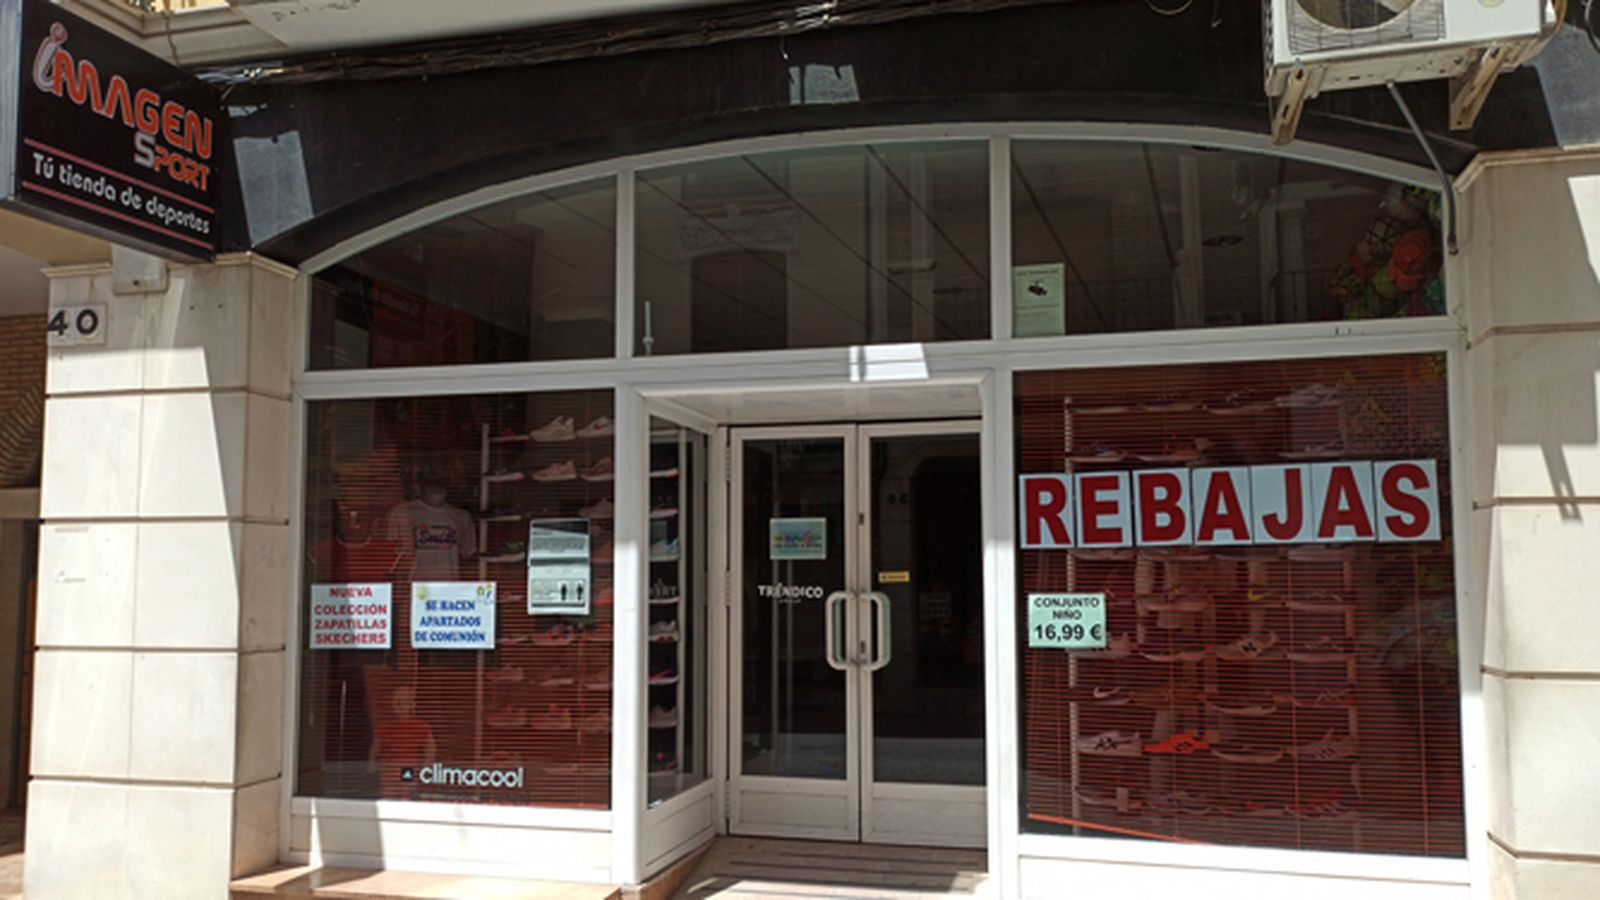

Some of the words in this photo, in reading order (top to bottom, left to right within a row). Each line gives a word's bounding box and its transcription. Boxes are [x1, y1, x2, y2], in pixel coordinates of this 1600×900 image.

[134, 131, 210, 191] SPORT
[33, 152, 54, 179] Tú
[59, 164, 116, 201] tienda
[121, 186, 142, 210] de
[146, 196, 210, 233] deportes
[47, 308, 99, 336] 40
[1024, 463, 1431, 545] REBAJAS
[329, 586, 373, 598] NUEVA
[425, 600, 438, 612] SE
[440, 600, 476, 612] HACEN
[1034, 597, 1100, 608] CONJUNTO
[314, 603, 388, 616] COLECCIÓN
[314, 619, 388, 630] ZAPATILLAS
[419, 616, 482, 627] APARTADOS
[315, 633, 387, 645] SKECHERS
[415, 631, 428, 642] DE
[429, 629, 486, 643] COMUNIÓN
[1034, 623, 1085, 642] 16,99
[1090, 623, 1103, 640] €
[419, 762, 524, 788] climacool
